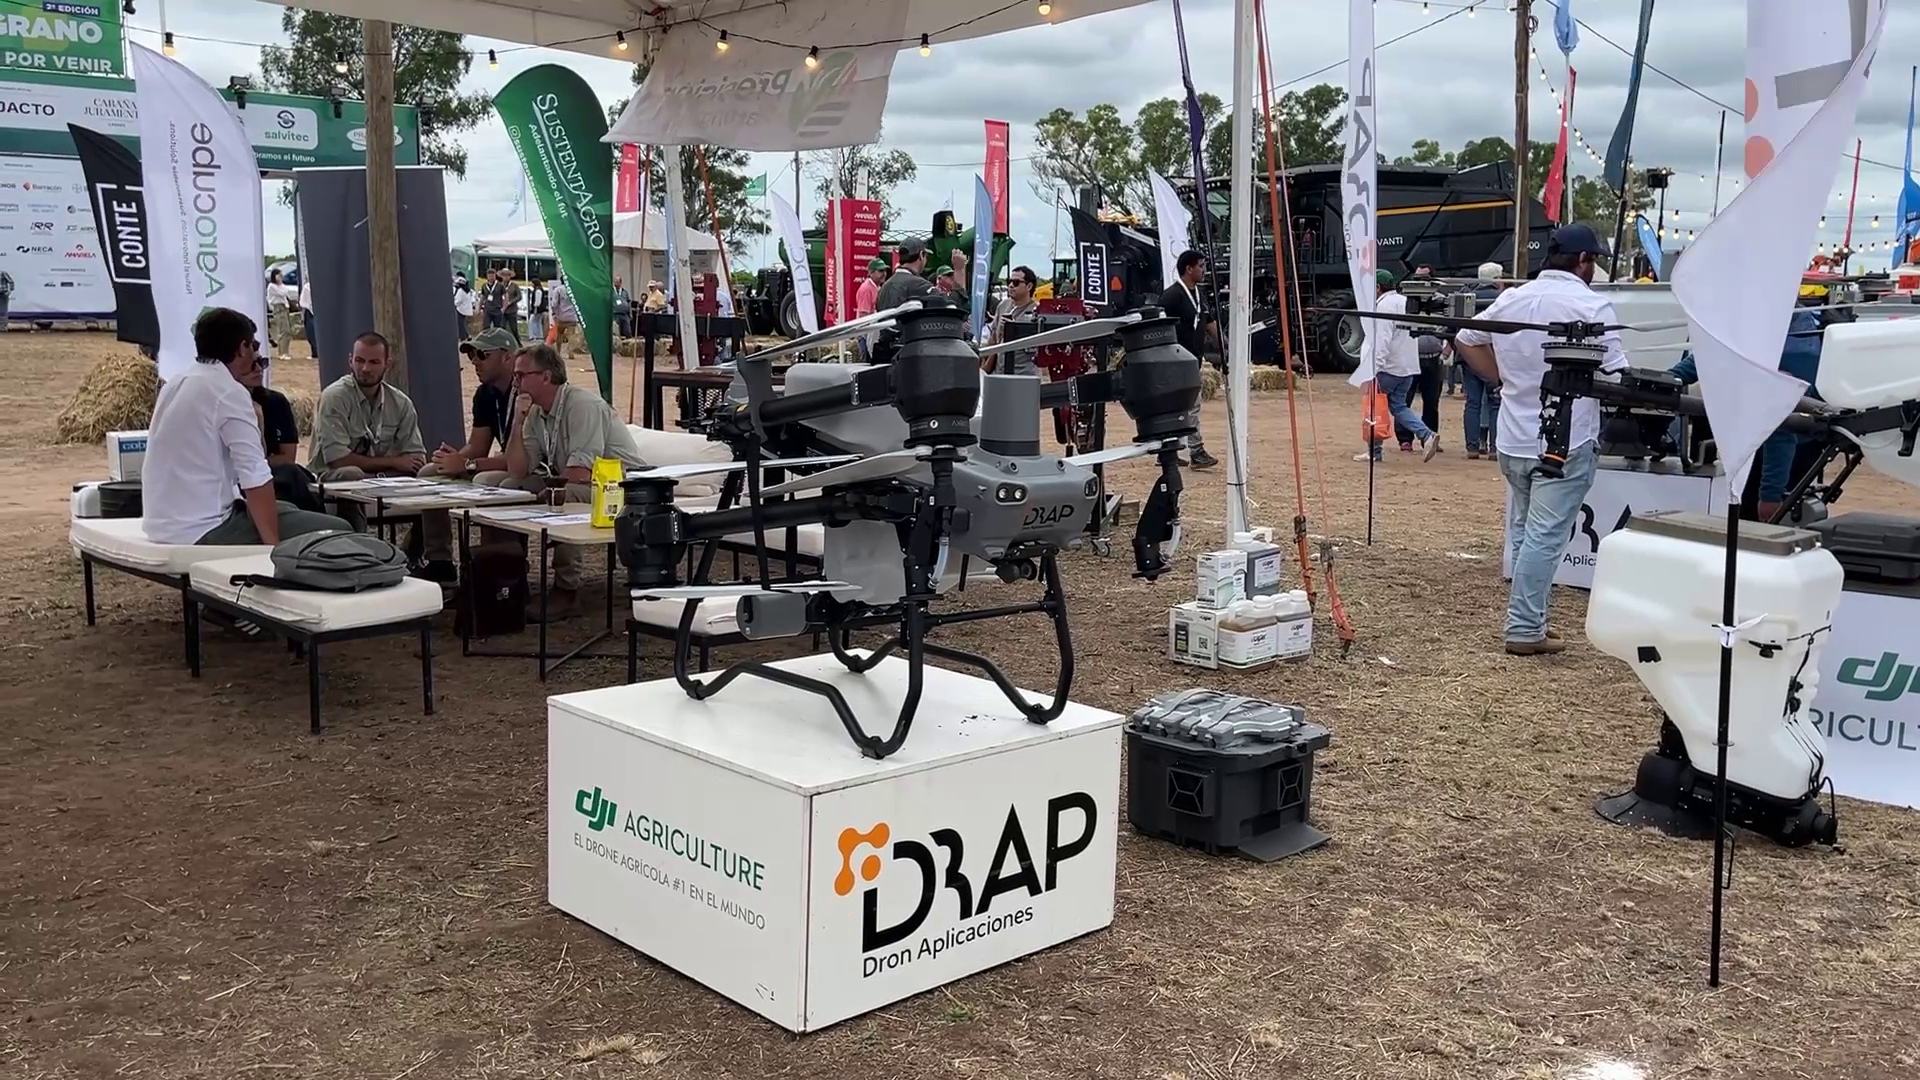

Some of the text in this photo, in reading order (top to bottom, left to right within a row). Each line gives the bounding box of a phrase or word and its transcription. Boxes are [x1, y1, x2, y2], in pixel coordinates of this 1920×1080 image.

[58, 4, 99, 15] EDICIÓN
[5, 51, 112, 72] POR VENIR
[264, 131, 309, 142] salvitec
[292, 154, 315, 162] futuro
[529, 123, 558, 189] Adelantando
[554, 190, 565, 202] el
[113, 201, 147, 269] CONTE
[1377, 236, 1403, 246] VANTI
[1526, 241, 1540, 250] 00
[1088, 252, 1101, 295] CONTE
[1023, 505, 1075, 526] DRAP
[1809, 708, 1920, 751] RICUL
[624, 810, 765, 890] AGRICULTURE
[574, 833, 766, 930] EL DRONE AGRÍCOLA #1 EN EL MUNDO
[862, 791, 1098, 954] DRAP
[863, 905, 1033, 979] Dron Aplicaciones
